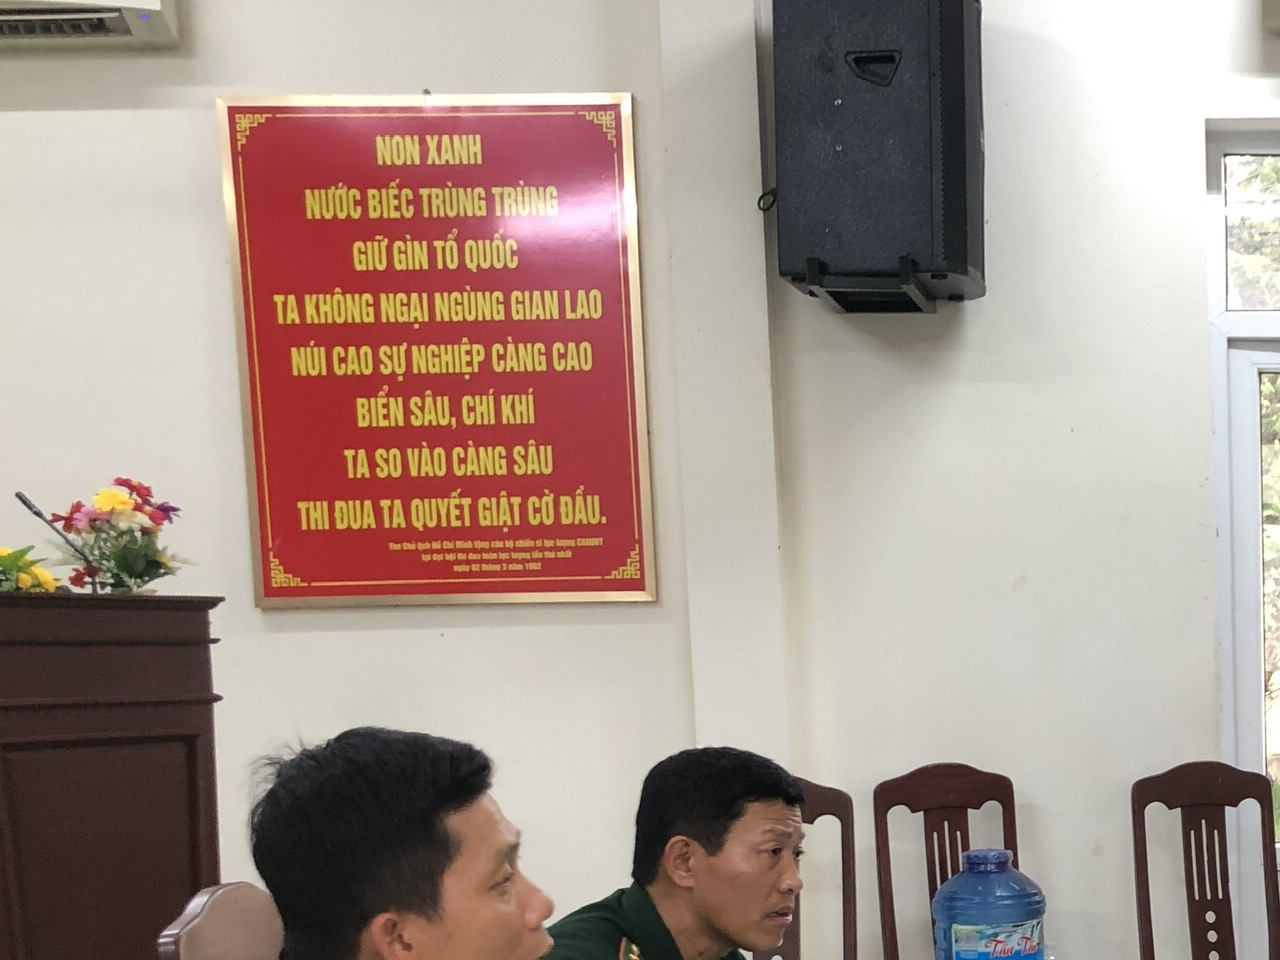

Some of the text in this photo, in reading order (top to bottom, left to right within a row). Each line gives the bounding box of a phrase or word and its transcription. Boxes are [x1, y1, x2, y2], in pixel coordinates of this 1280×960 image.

[376, 135, 482, 165] NON XANH
[305, 178, 559, 219] NƯỚC BIẾC TRÙNG TRÙNG
[353, 228, 518, 272] GIỮ GÌN TỔ QUỐC
[273, 286, 602, 329] TA KHÔNG NGẠI NGÙNG GIAN LAO
[291, 337, 592, 381] NÚI CAO SỰ NGHIỆP CÀNG CAO
[356, 386, 534, 429] BIỂN SÂU, CHÍ KHÍ
[344, 440, 553, 478] TA SO VÀO CÀNG SÂU
[297, 486, 606, 532] THI ĐUA TA QUYẾT GIẬT CỜ ĐẦU.
